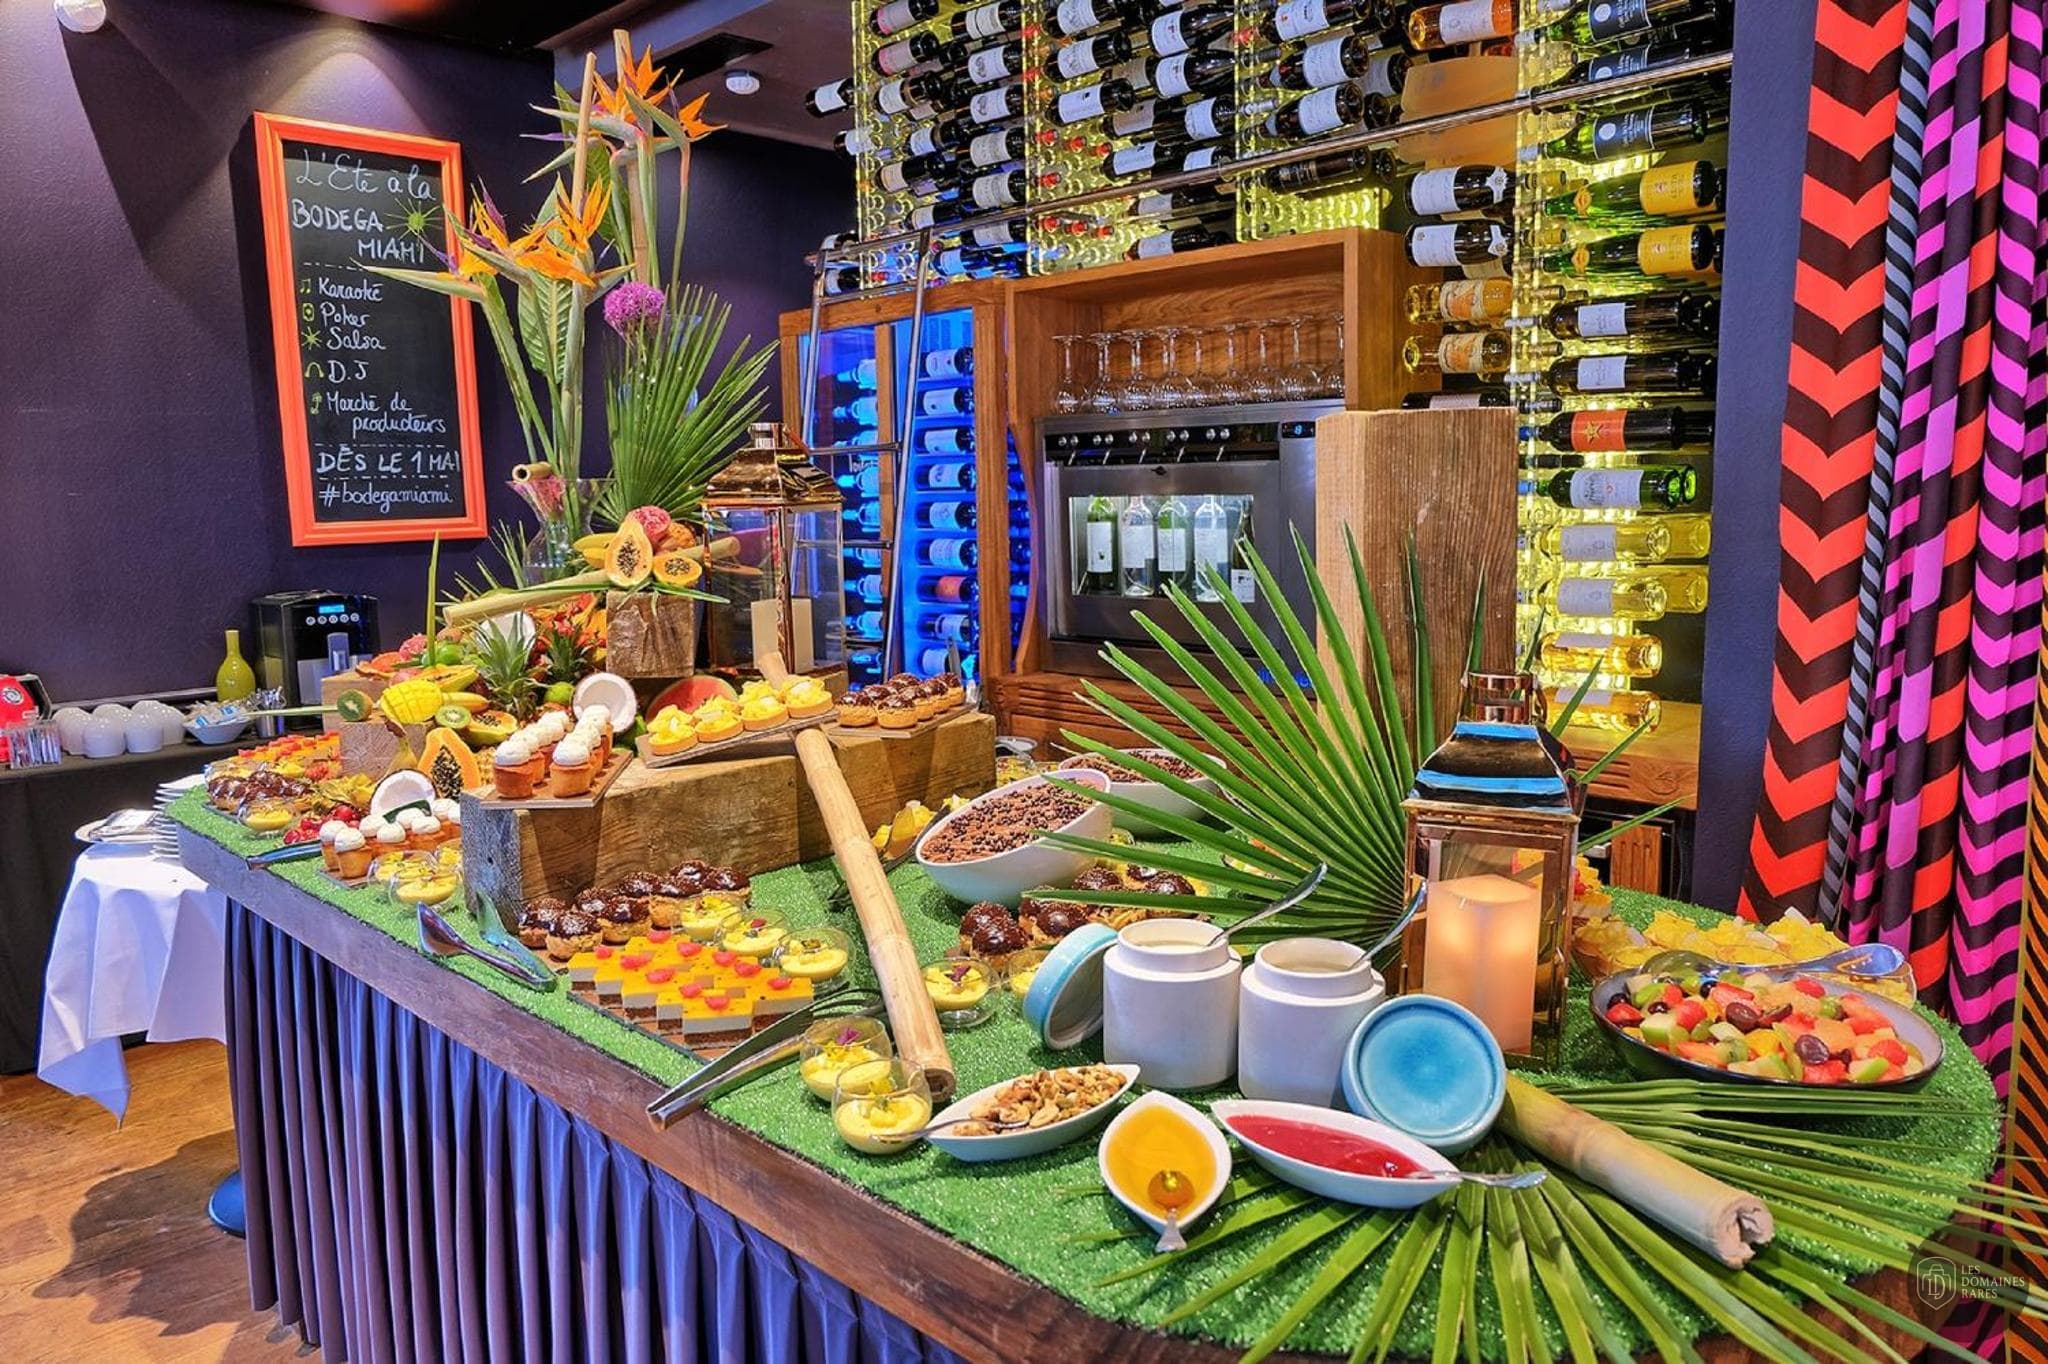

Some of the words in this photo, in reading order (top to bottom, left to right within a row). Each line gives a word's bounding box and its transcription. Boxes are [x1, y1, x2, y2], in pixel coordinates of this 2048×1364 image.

[407, 164, 436, 201] la
[291, 198, 384, 233] BODEGA
[357, 237, 424, 264] MIAMI
[319, 277, 383, 301] Karaoké
[320, 301, 370, 328] Poker
[326, 326, 387, 350] Salsa
[326, 390, 381, 415] Marché
[390, 391, 413, 411] de
[352, 411, 446, 440] producteurs
[378, 452, 403, 473] LE
[410, 450, 422, 474] 1
[429, 450, 460, 473] MAI
[318, 481, 453, 513] #bodegamiami
